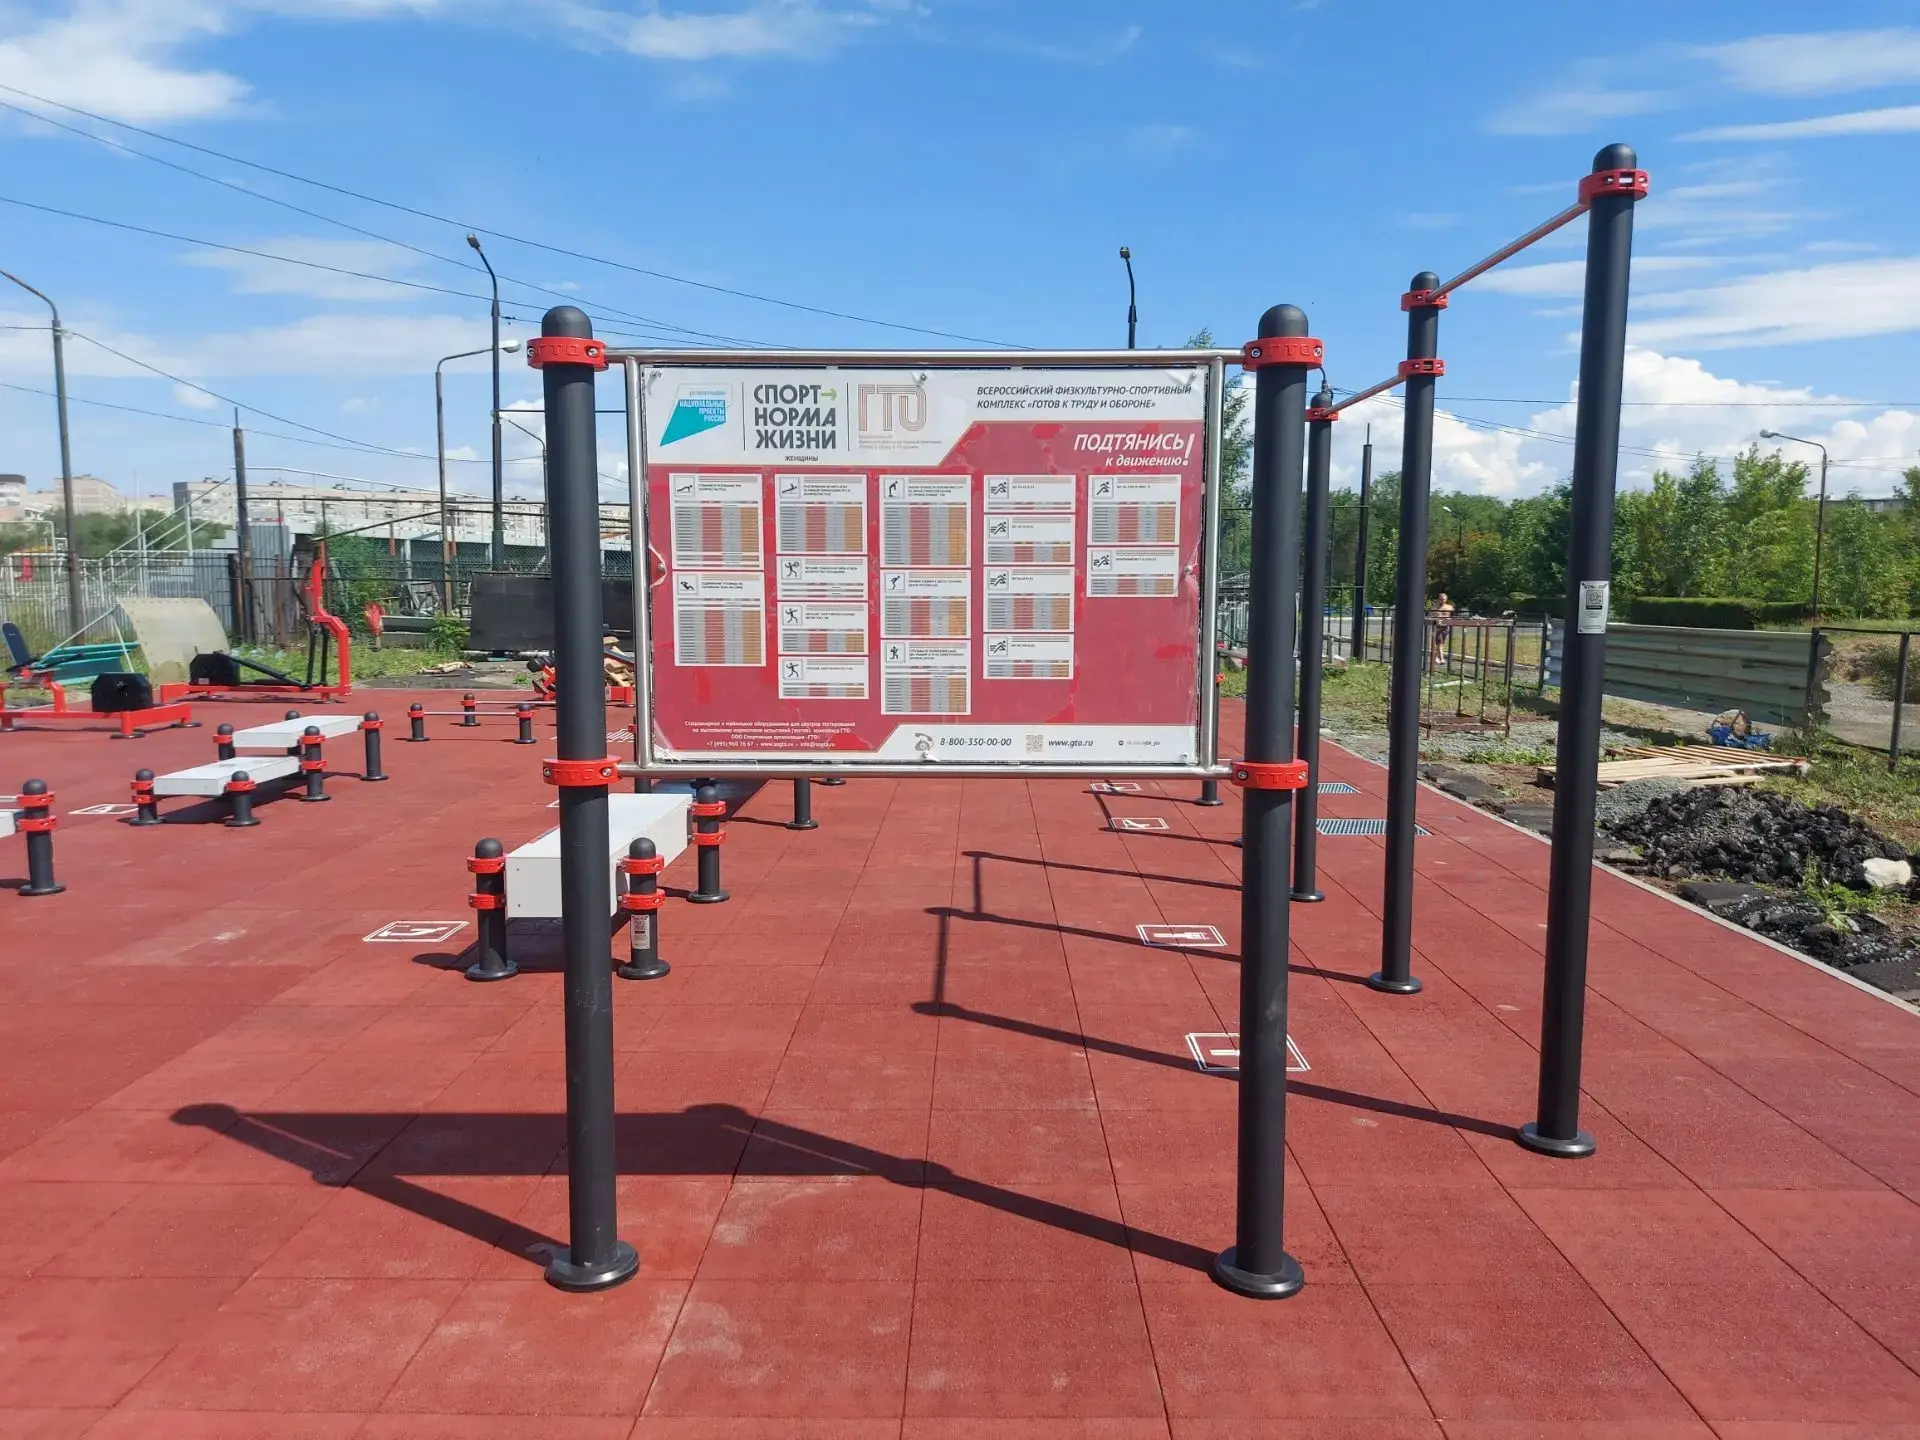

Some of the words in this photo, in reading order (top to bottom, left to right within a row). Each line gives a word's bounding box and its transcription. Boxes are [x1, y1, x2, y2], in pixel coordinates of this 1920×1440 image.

[753, 384, 822, 405] СПОРТ
[977, 384, 1054, 396] ВСЕРОССИЙСКИЙ
[1055, 384, 1192, 395] ФИЗКУЛЬТУРНО-СПОРТИВНЫЙ
[679, 400, 725, 408] НАЦИОНАЛЬНЫЕ
[858, 384, 927, 432] ГТО
[977, 399, 1027, 409] КОМПЛЕКС
[1027, 399, 1060, 409] «ГОТОВ
[1062, 399, 1069, 409] К
[1071, 399, 1099, 410] ТРУДУ
[1100, 399, 1107, 409] И
[1109, 399, 1156, 409] ОБОРОНЕ»
[698, 407, 725, 415] ПРОЕКТЫ
[754, 407, 836, 427] НОРМА
[755, 429, 837, 449] ЖИЗНИ
[940, 737, 1012, 746] 8-800-350-00-00
[1048, 739, 1094, 749] www.gto.ru
